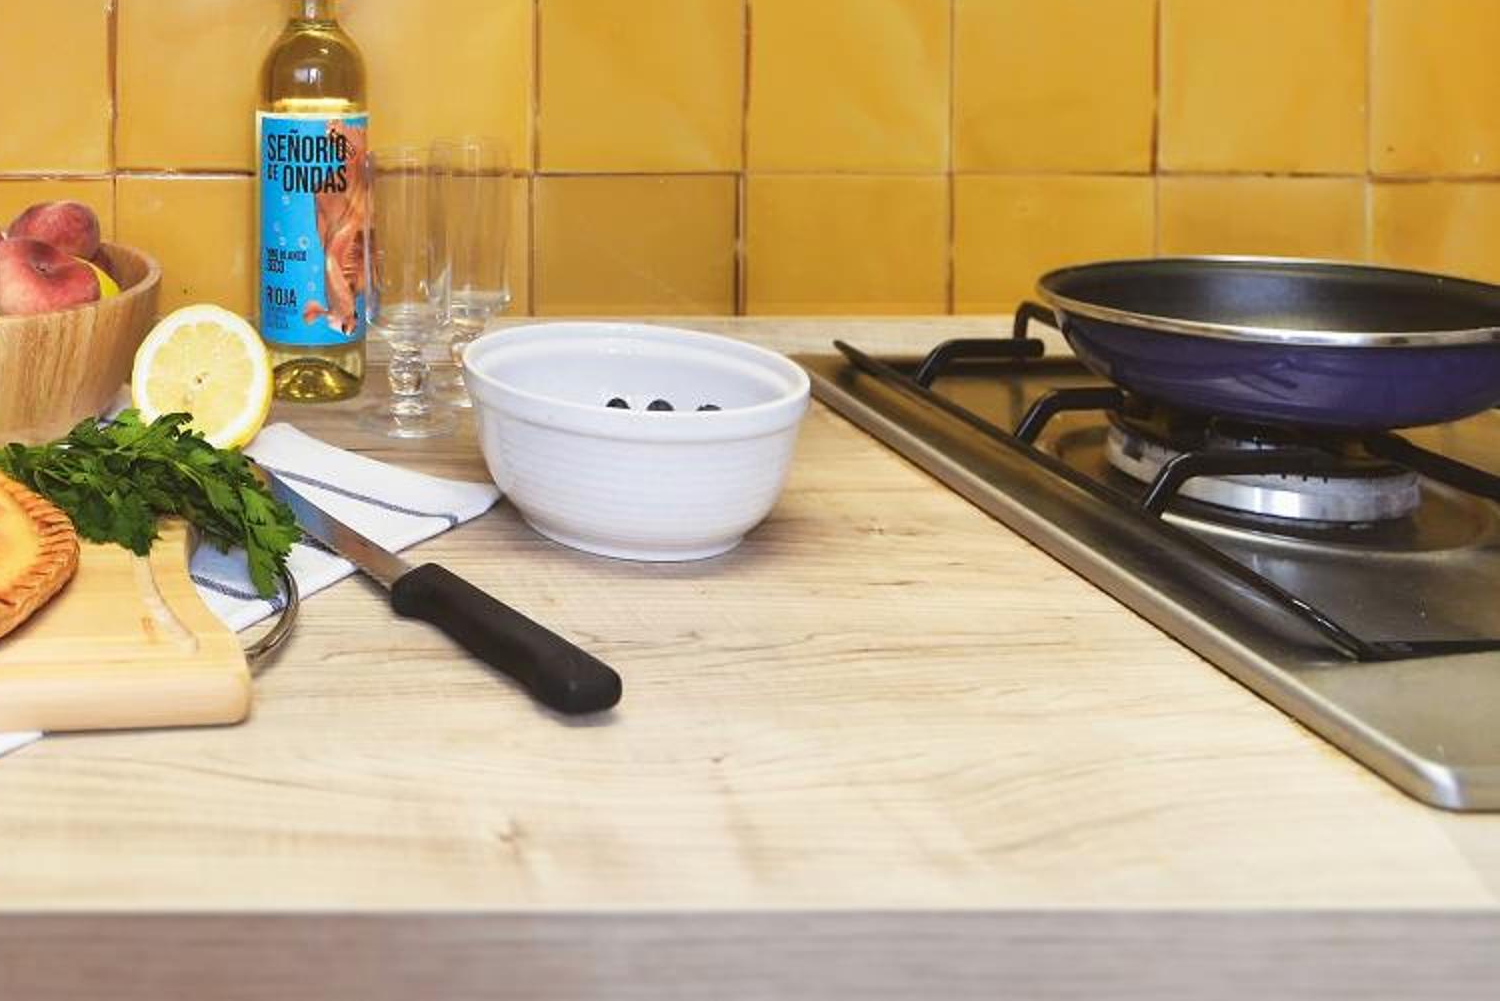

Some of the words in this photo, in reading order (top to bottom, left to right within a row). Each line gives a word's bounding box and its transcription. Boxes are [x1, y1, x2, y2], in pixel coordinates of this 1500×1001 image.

[267, 129, 347, 163] SEÑORÍO
[283, 164, 348, 193] ONDAS
[267, 285, 297, 307] ROJA
